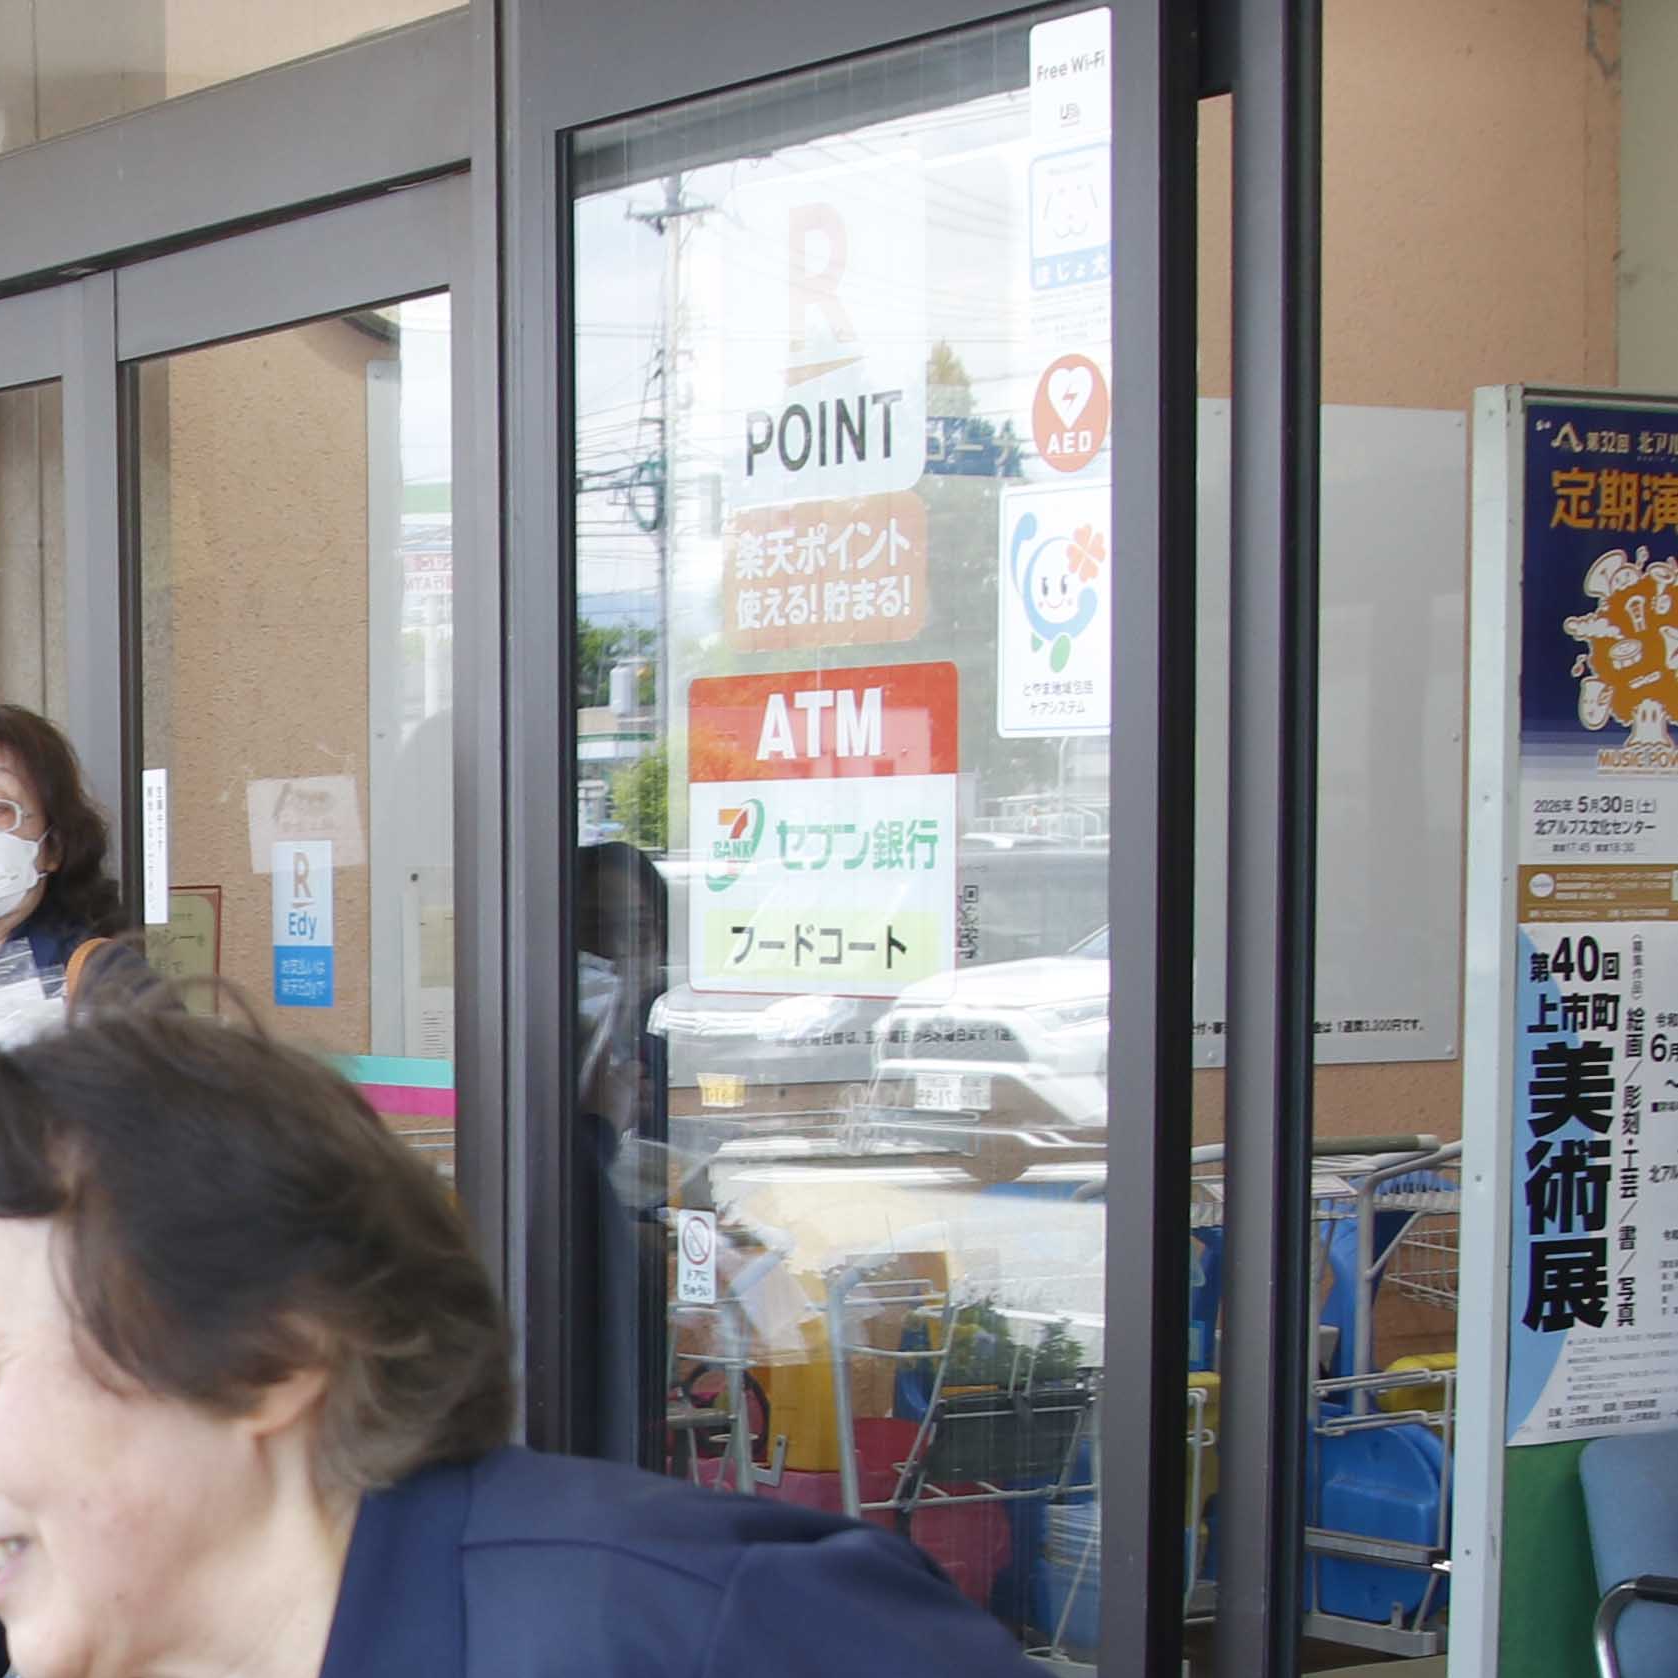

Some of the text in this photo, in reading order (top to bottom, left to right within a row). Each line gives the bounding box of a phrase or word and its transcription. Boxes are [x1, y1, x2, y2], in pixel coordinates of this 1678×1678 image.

[746, 390, 903, 476] POINT
[1047, 430, 1093, 455] AED
[736, 518, 911, 580] 楽天ポイント
[756, 687, 883, 760] ATM
[776, 820, 939, 870] セブン銀行
[288, 911, 318, 941] Edy
[730, 924, 907, 969] フードコート
[1530, 935, 1621, 983] 第40回
[1526, 993, 1619, 1034] 上市町
[1521, 1040, 1616, 1334] 美術展
